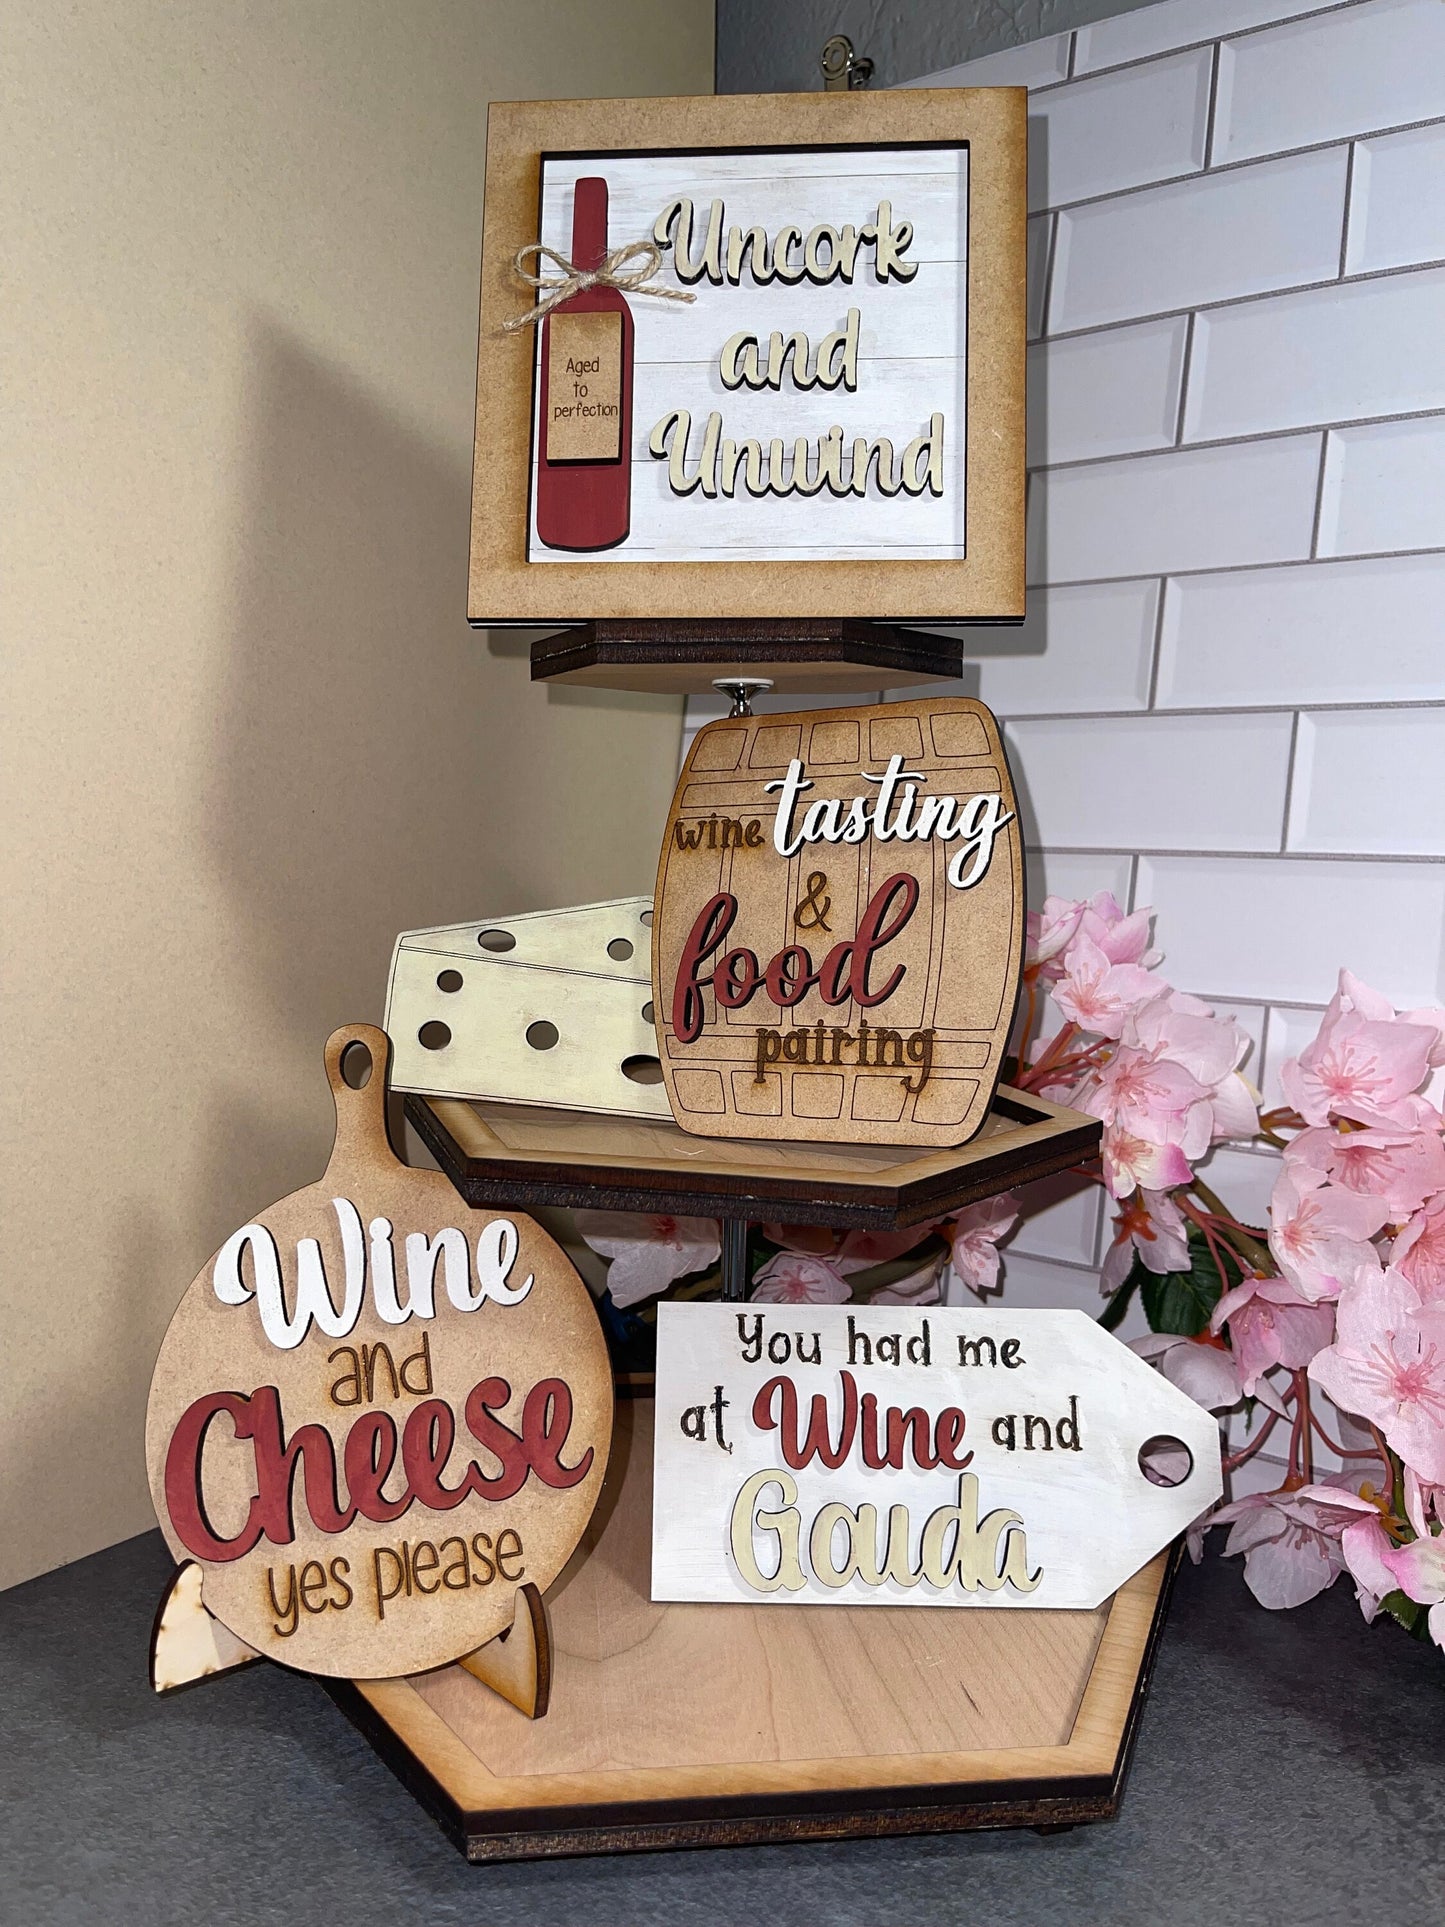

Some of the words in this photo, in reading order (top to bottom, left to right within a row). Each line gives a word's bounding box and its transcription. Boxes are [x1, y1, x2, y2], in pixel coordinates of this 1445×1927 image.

[654, 199, 919, 286] Uncork
[565, 356, 600, 377] Aged
[573, 381, 588, 397] to
[720, 308, 861, 392] and
[554, 402, 618, 421] perfection
[649, 410, 944, 498] Unwind
[676, 813, 765, 850] wine
[764, 755, 1015, 889] tasting
[794, 871, 833, 932] &
[672, 872, 919, 1044] food
[754, 1019, 936, 1093] pairing
[213, 1197, 534, 1349] Wine
[328, 1331, 433, 1406] and
[847, 1315, 931, 1366] had
[958, 1334, 1026, 1369] me
[680, 1386, 733, 1454] at
[752, 1370, 974, 1471] Wine
[991, 1395, 1083, 1451] and
[730, 1468, 1043, 1592] Gouda
[268, 1556, 353, 1637] yes
[373, 1528, 525, 1619] please
